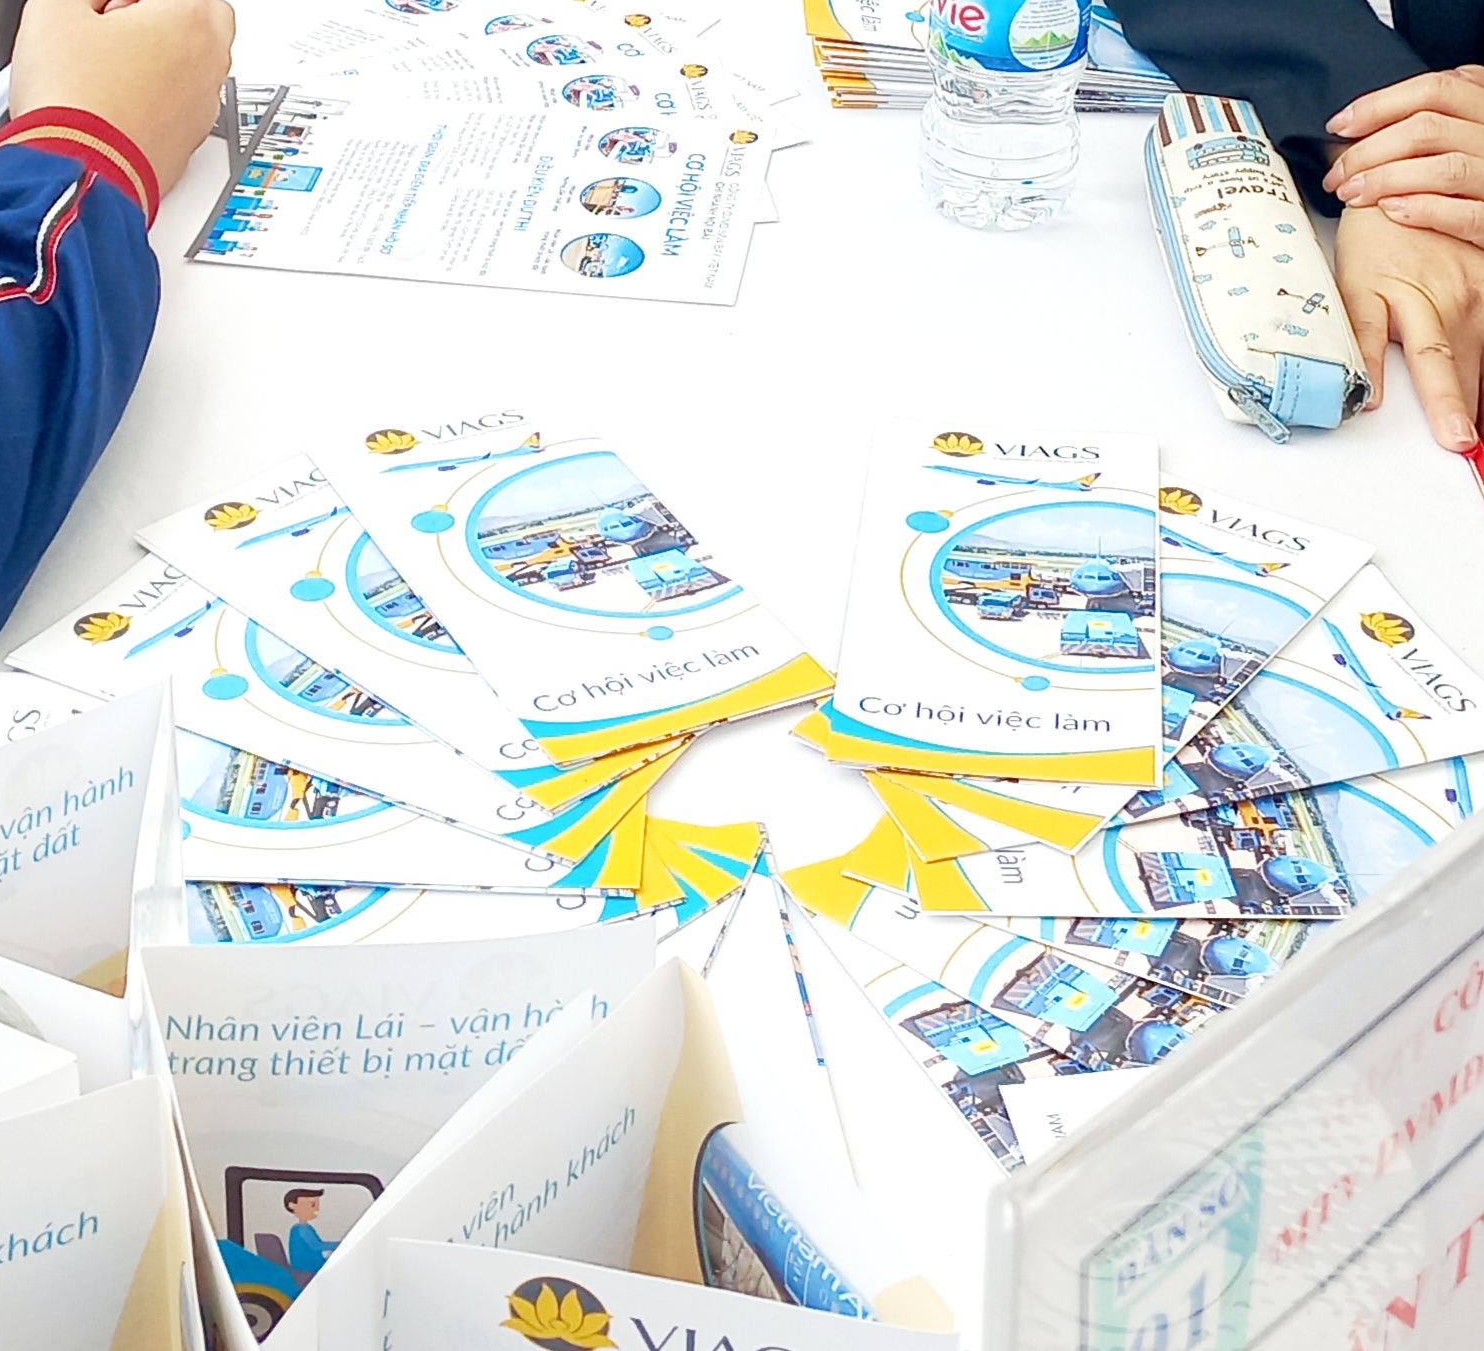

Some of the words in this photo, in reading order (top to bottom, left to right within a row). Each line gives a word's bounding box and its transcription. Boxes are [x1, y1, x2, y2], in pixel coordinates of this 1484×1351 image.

[685, 153, 706, 172] CƠ
[676, 173, 701, 196] HỘI
[1217, 185, 1294, 205] Travel
[668, 199, 695, 225] VIỆC
[661, 228, 689, 257] LÀM
[421, 409, 524, 439] VIAGS
[995, 443, 1100, 460] VIAGS
[1211, 509, 1310, 551] VIAGS
[533, 690, 577, 712] Cơ
[581, 675, 634, 699] hội
[637, 661, 701, 685] việc
[702, 644, 760, 668] làm
[1401, 647, 1477, 713] VIAGS
[859, 696, 906, 716] Cơ
[915, 701, 965, 725] hội
[976, 711, 1042, 731] việc
[1054, 713, 1111, 732] làm
[0, 805, 52, 840] vận
[63, 767, 134, 815] hành
[32, 820, 81, 863] đất
[994, 849, 1027, 885] làm
[166, 1014, 260, 1042] Nhân
[270, 1014, 343, 1041] viên
[355, 1012, 406, 1040] Lái
[450, 1007, 512, 1041] vận
[167, 1049, 257, 1083] trang
[269, 1044, 351, 1077] thiết
[362, 1047, 392, 1079] bị
[405, 1044, 472, 1076] mặt
[494, 1178, 558, 1248] hành
[566, 1105, 636, 1188] khách
[462, 1182, 515, 1240] viên
